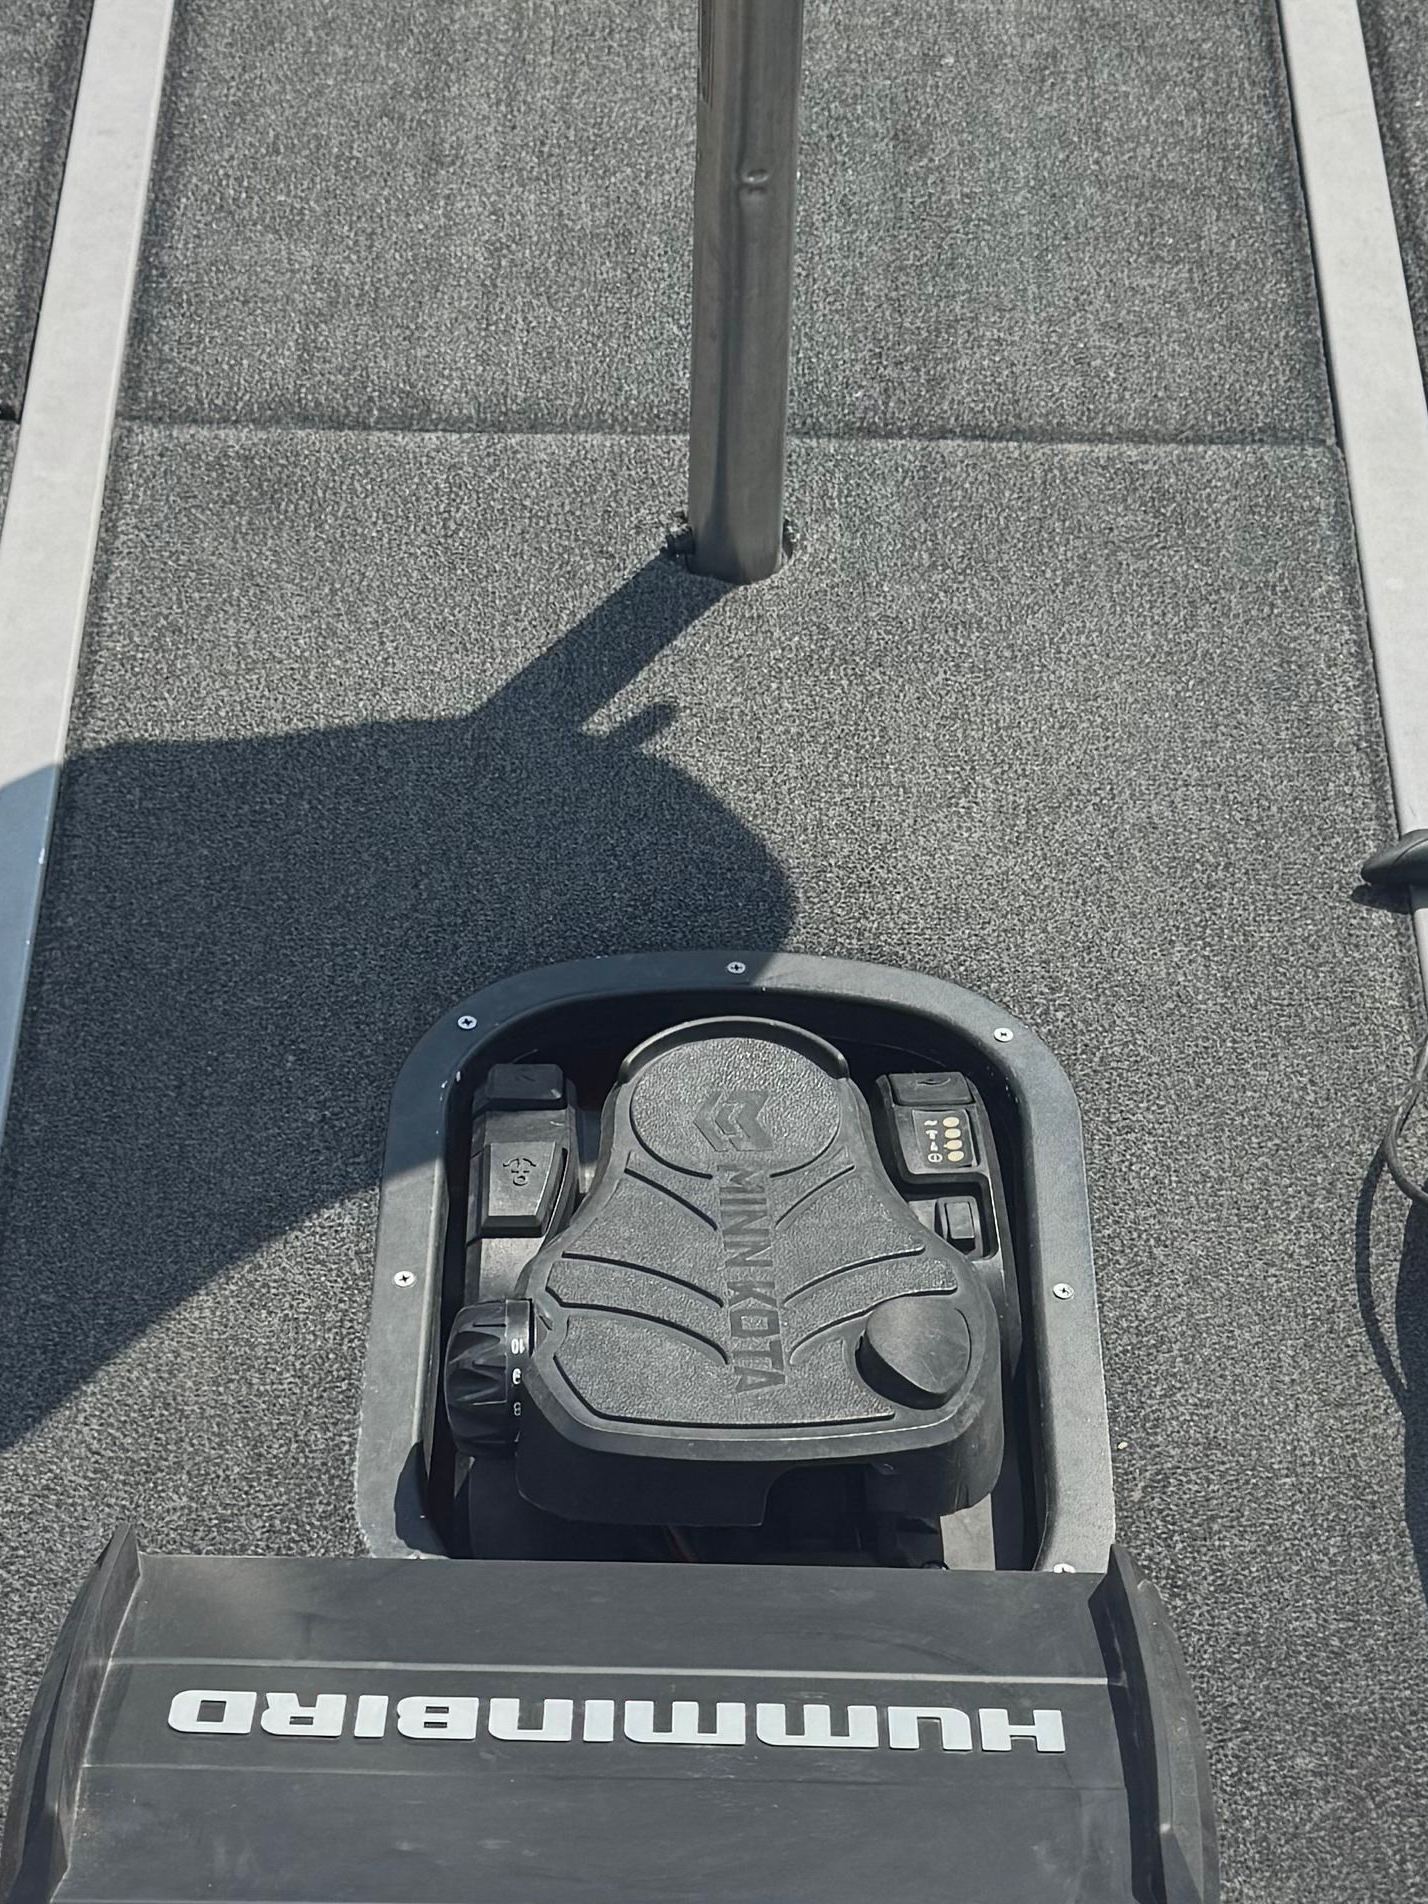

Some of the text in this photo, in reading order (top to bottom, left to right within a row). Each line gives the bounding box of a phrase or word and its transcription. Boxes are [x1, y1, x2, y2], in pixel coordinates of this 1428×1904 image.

[717, 1163, 786, 1394] MINN KOTA
[510, 1338, 525, 1355] 10
[167, 1689, 1067, 1754] HUMMINBIRD
